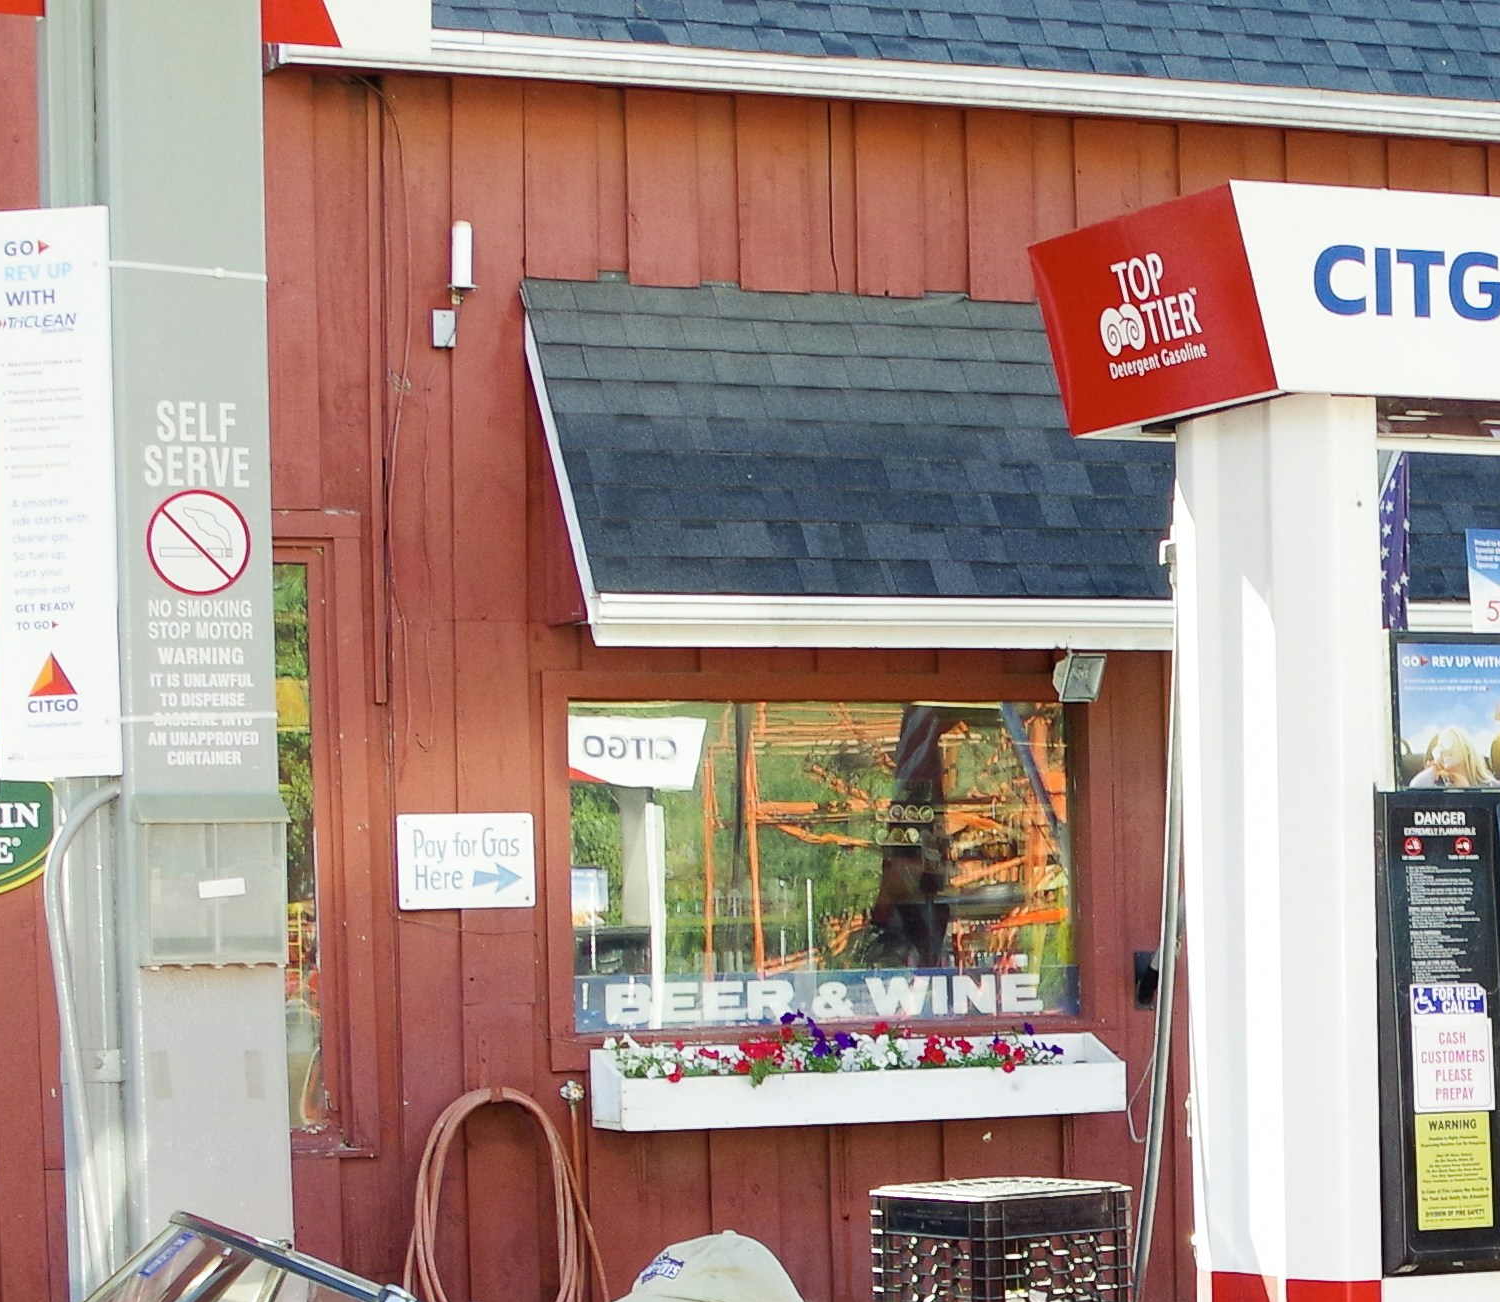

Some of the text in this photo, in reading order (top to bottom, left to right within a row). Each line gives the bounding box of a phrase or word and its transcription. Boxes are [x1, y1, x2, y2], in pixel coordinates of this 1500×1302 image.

[4, 240, 34, 257] GO
[4, 262, 73, 282] REV UP
[1110, 252, 1164, 303] TOP
[5, 289, 56, 307] WITH
[7, 313, 77, 330] TriCLEAN
[1109, 342, 1208, 380] Detergent Gasoline
[156, 401, 236, 443] SELF
[144, 444, 250, 488] SERVE
[16, 602, 75, 614] GET READY
[148, 599, 252, 618] NO SMOKING
[17, 620, 50, 631] TO GO
[148, 622, 253, 640] STOP MOTOR
[157, 648, 244, 666] WARNING
[1402, 656, 1420, 667] GO
[1432, 656, 1454, 668] REV
[1456, 656, 1471, 668] UP
[150, 673, 254, 688] IT IS UNLAWFUL
[27, 698, 79, 714] CITGO
[160, 693, 245, 707] TO DISPENSE
[148, 731, 259, 746] AN UNAPPROVED
[167, 751, 242, 765] CONTAINER
[1414, 811, 1466, 825] DANGER
[1404, 826, 1476, 836] EXTREMELY FLAMMABLE
[413, 827, 519, 863] Pay for Gas
[415, 864, 463, 890] Here
[605, 974, 1044, 1028] BEER & WINE
[1432, 987, 1484, 1000] FOR HELP
[1442, 1000, 1475, 1013] CALL:
[1438, 1032, 1466, 1044] CASH
[1421, 1050, 1485, 1063] CUSTOMERS
[1435, 1069, 1472, 1082] PLEASE
[1435, 1087, 1474, 1100] PREPAY
[1428, 1119, 1477, 1131] WARNING
